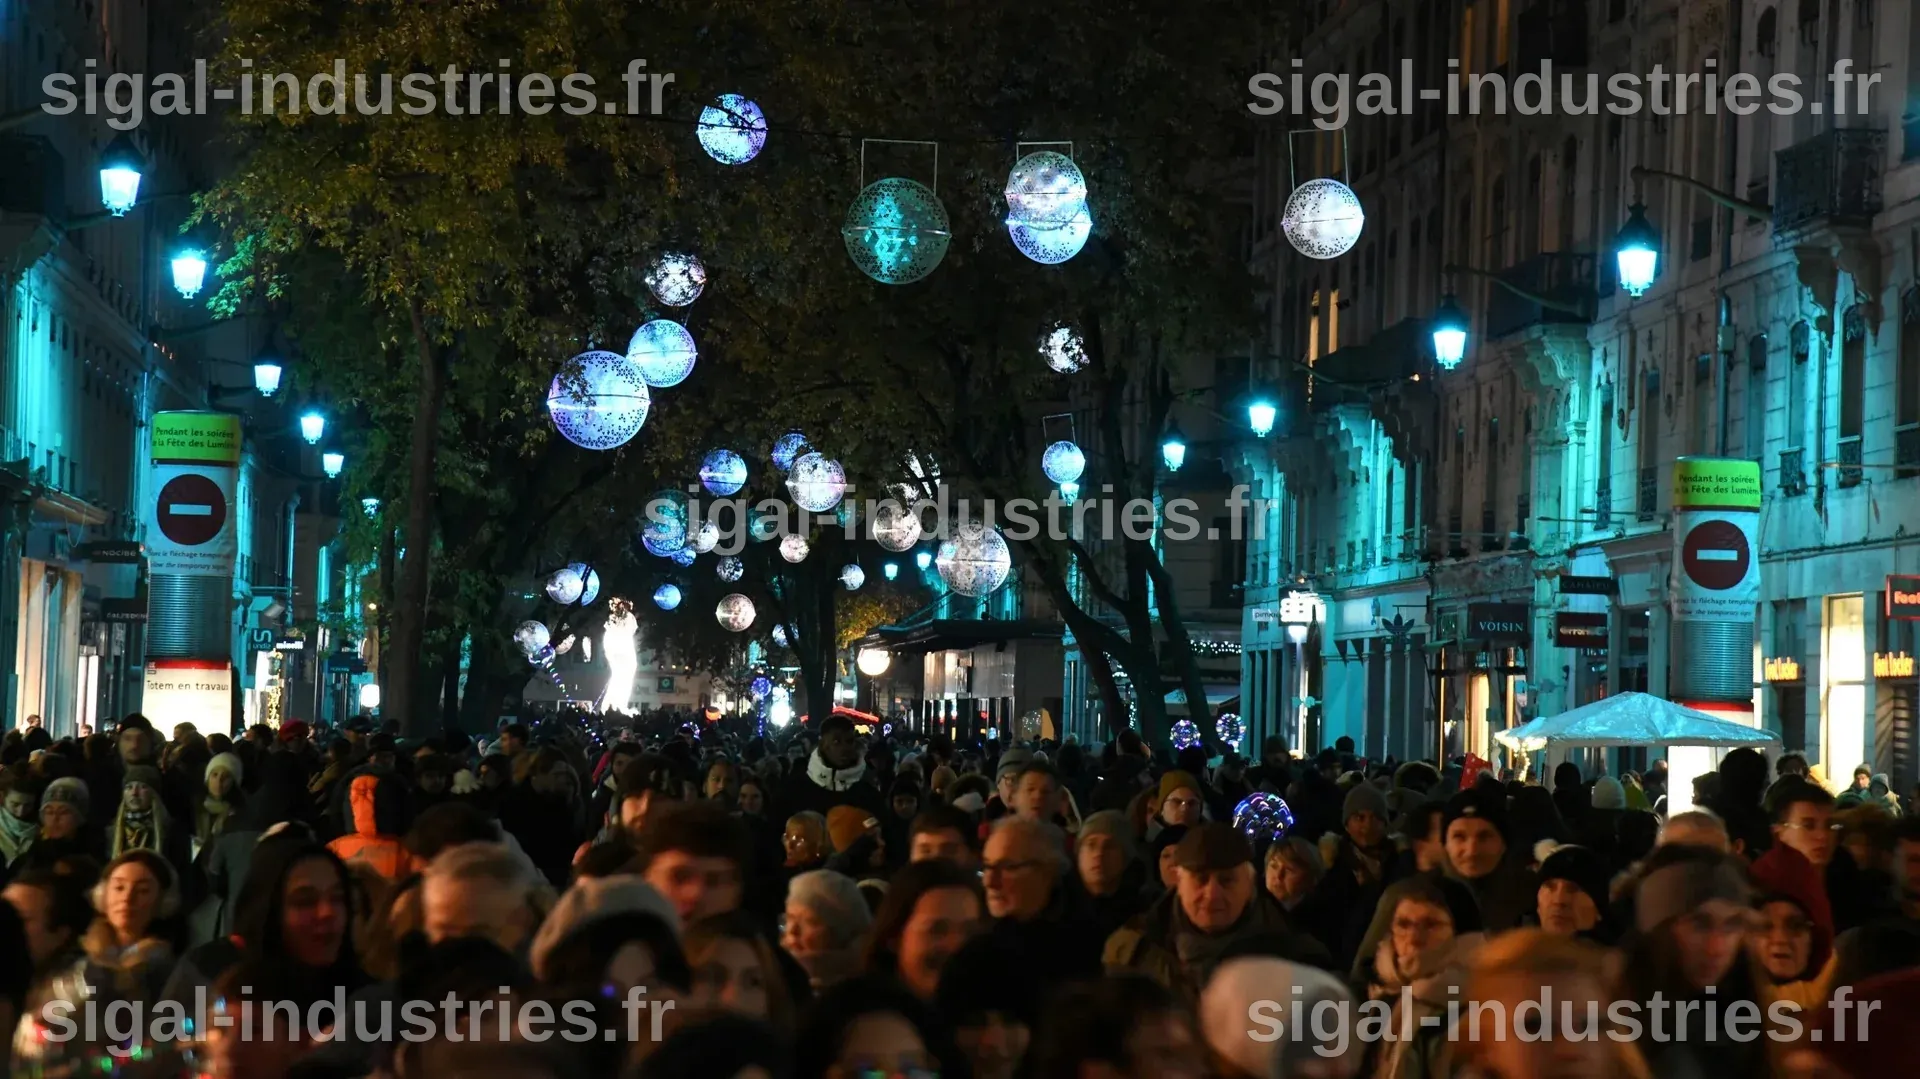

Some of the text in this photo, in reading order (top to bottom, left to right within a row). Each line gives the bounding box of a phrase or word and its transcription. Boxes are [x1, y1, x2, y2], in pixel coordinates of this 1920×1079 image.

[155, 426, 188, 436] Pendant
[191, 428, 204, 437] les
[166, 438, 186, 447] Fête
[188, 439, 204, 448] des
[1679, 474, 1713, 483] Pendant
[1715, 475, 1728, 483] les
[1691, 484, 1711, 494] Fête
[1713, 485, 1729, 494] des
[1479, 621, 1524, 633] VOISIN
